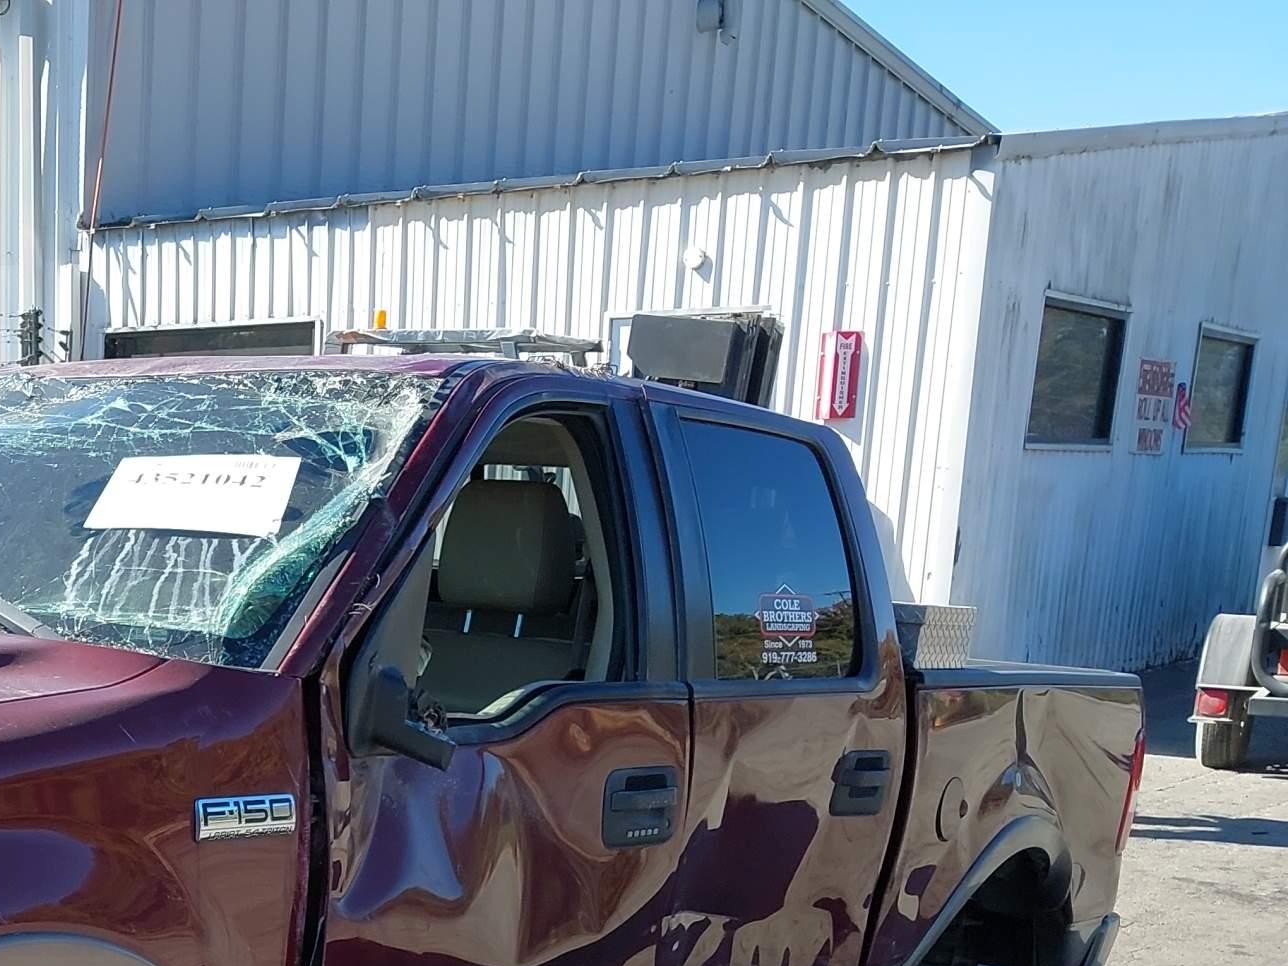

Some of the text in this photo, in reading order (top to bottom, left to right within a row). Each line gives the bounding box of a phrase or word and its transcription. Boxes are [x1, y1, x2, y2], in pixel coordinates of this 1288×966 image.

[839, 342, 853, 350] FIRE
[128, 472, 266, 488] 43521042
[774, 599, 800, 610] COLE
[763, 611, 812, 622] BROTHERS
[766, 623, 810, 631] LANDSCAPING
[764, 639, 813, 649] Since 1973
[762, 651, 817, 663] 919-777-3286
[201, 798, 292, 827] F-150
